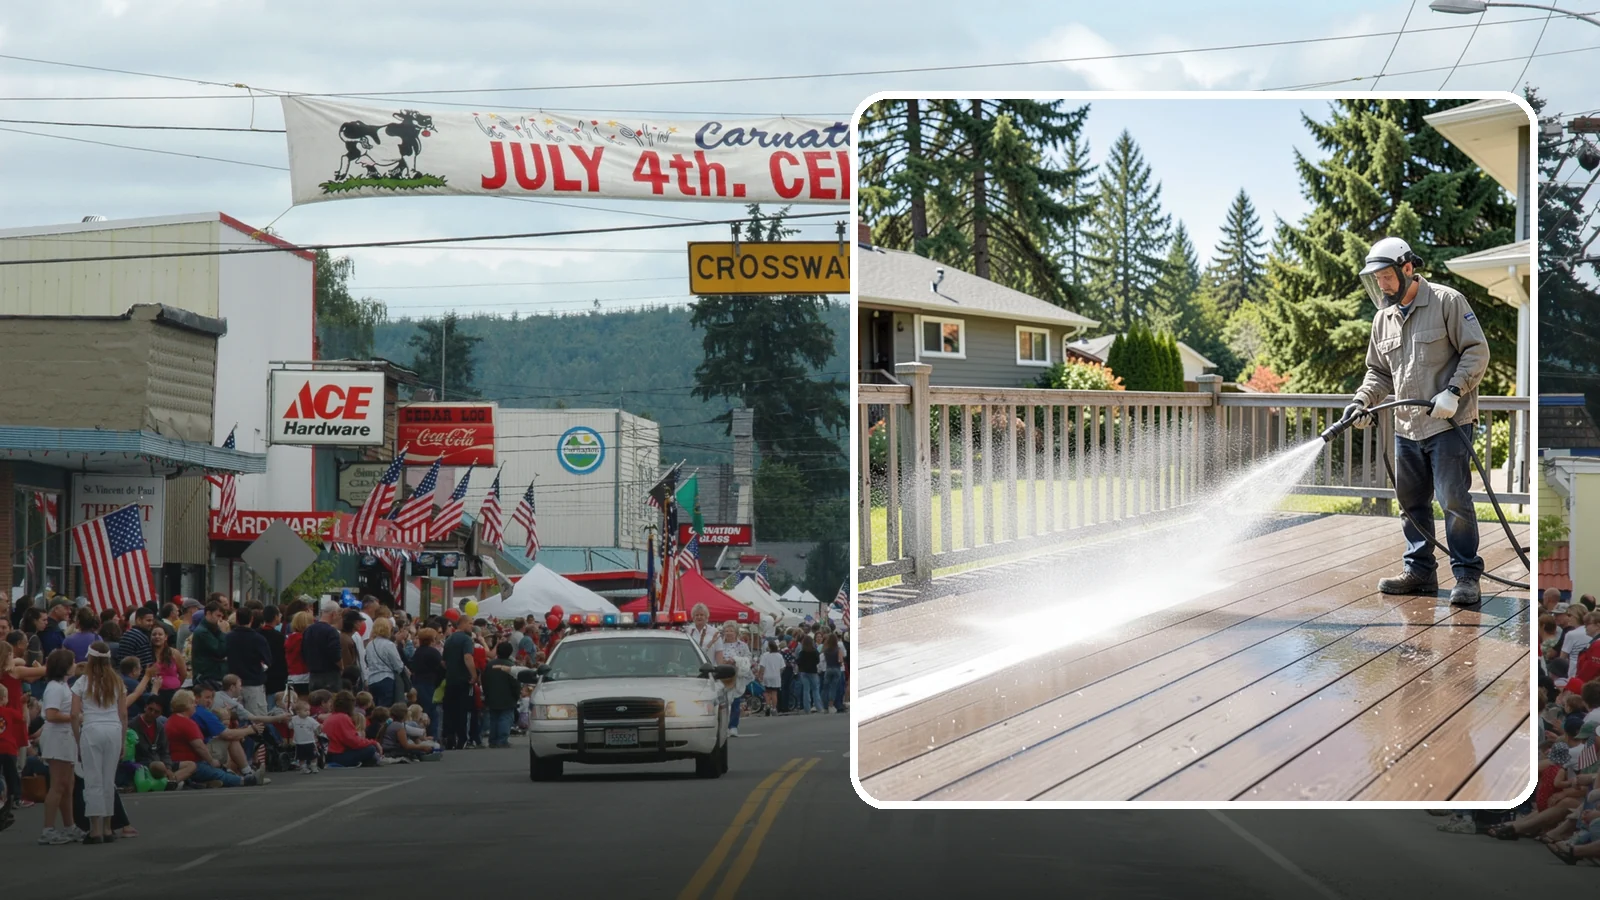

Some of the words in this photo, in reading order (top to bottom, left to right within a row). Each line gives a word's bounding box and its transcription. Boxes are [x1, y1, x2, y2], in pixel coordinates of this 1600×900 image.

[695, 121, 850, 149] Carnat
[481, 141, 605, 192] JULY
[632, 150, 747, 198] 4th.
[697, 254, 850, 280] CROSSWA
[282, 380, 374, 420] ACE
[406, 409, 453, 422] CEDAR
[283, 421, 371, 436] Hardware
[416, 428, 477, 446] Coca-Cola
[83, 485, 94, 494] St.
[95, 485, 124, 495] Vincent
[126, 486, 136, 495] de
[137, 485, 155, 495] Paul
[688, 526, 742, 535] CRNATION
[699, 535, 731, 543] GLASS
